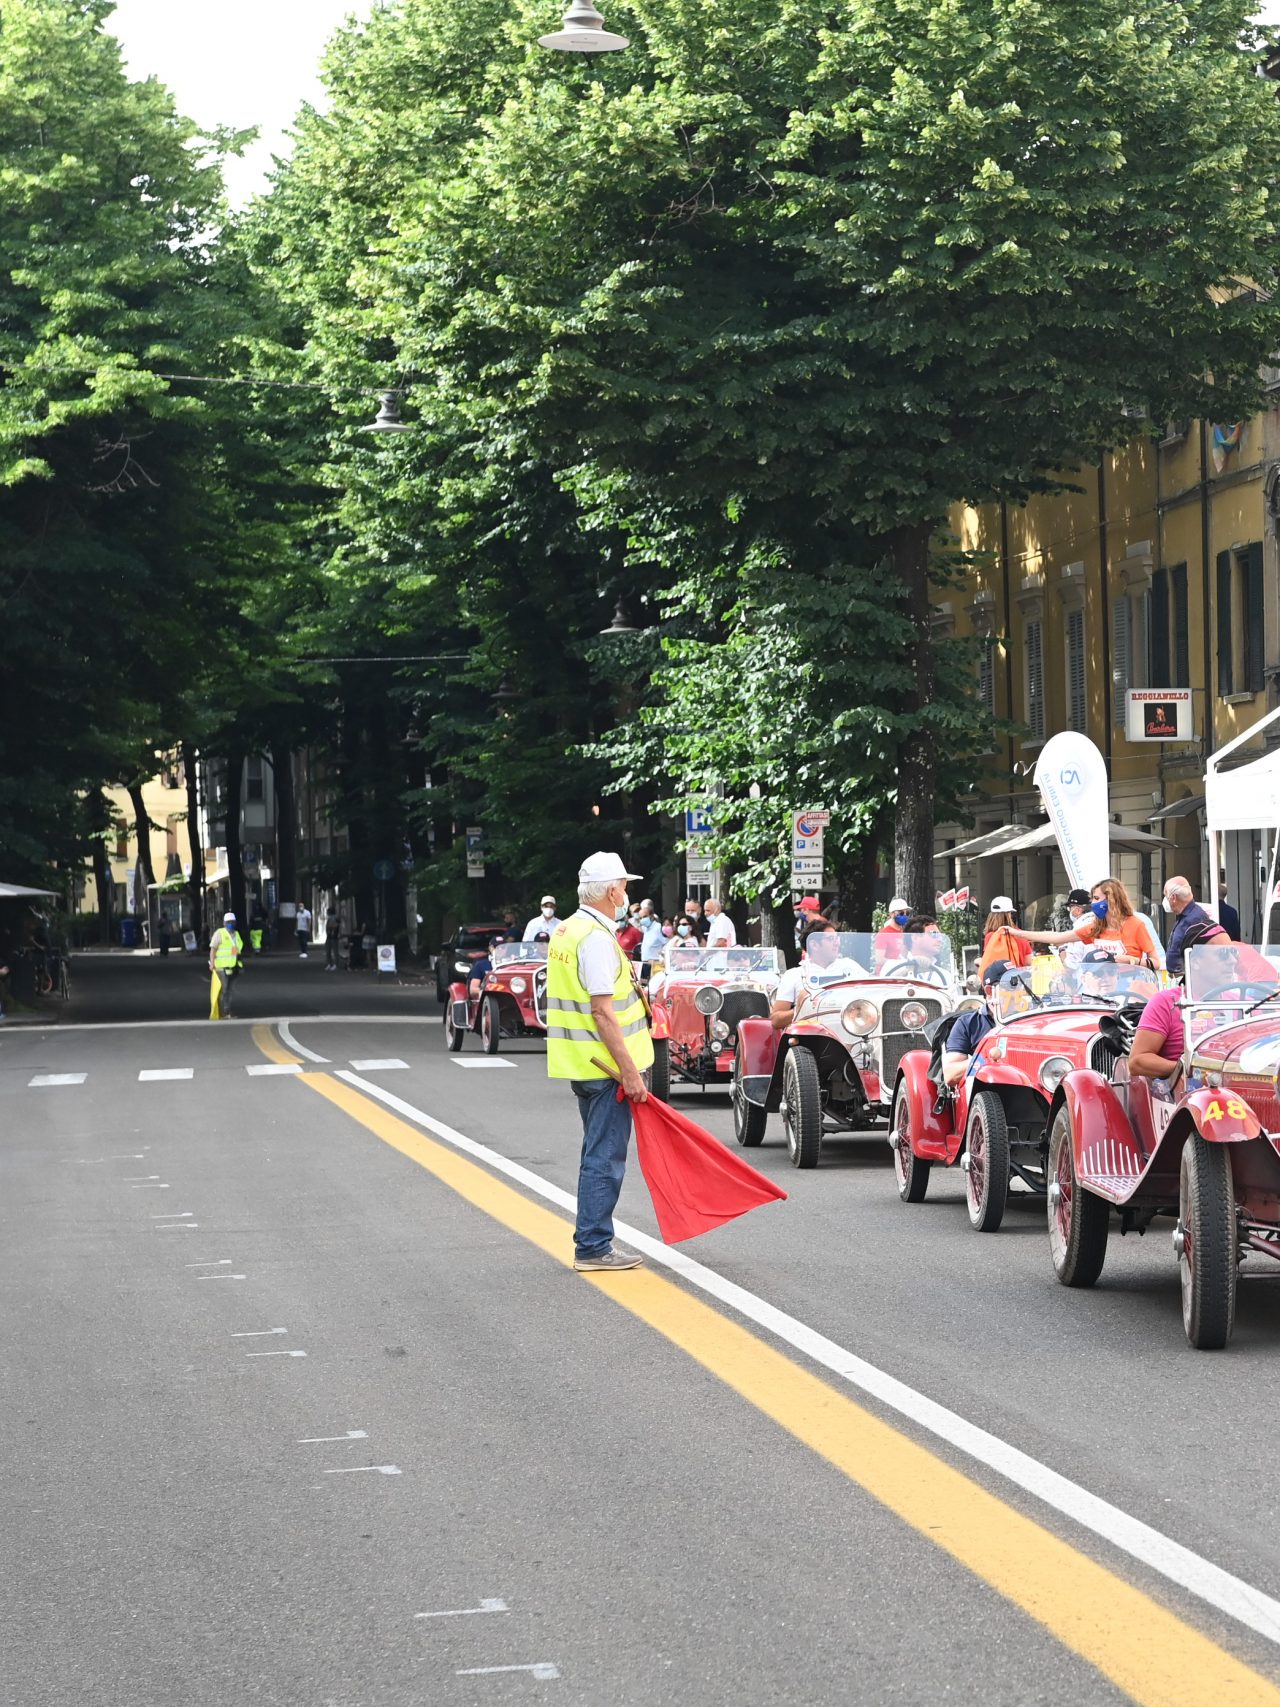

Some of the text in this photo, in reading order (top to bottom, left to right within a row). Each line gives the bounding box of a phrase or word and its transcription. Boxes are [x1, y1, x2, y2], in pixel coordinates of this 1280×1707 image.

[1131, 692, 1189, 701] REGGIANELLO
[1000, 990, 1029, 1013] 75
[1204, 1100, 1247, 1121] 48
